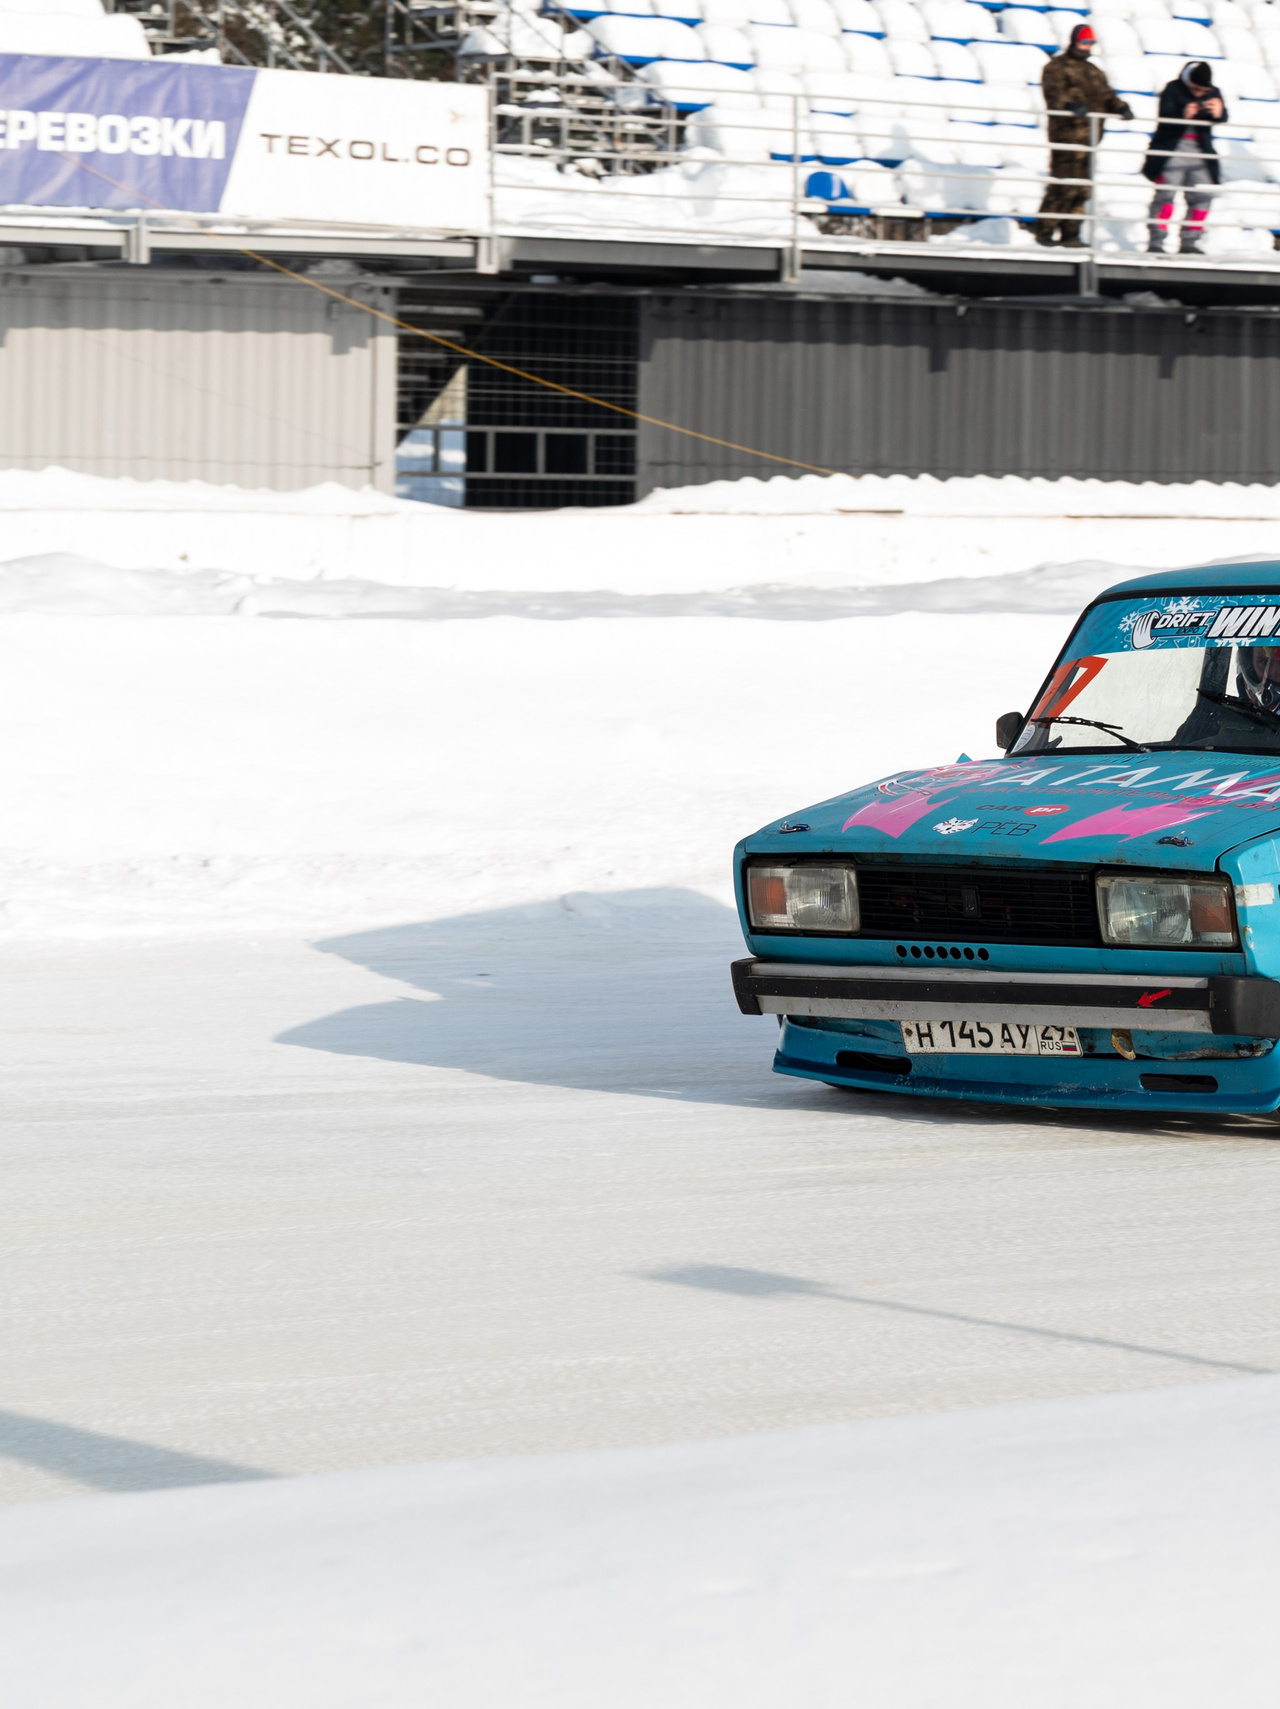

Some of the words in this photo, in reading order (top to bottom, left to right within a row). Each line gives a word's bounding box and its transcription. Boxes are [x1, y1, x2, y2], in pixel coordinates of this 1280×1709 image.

[0, 110, 226, 159] РЕВОЗКИ
[260, 133, 471, 167] TEXOL.CO
[1154, 611, 1216, 629] DRIFT
[1176, 627, 1200, 635] EXPO
[976, 804, 1027, 812] CAR
[1040, 1040, 1062, 1050] RUS
